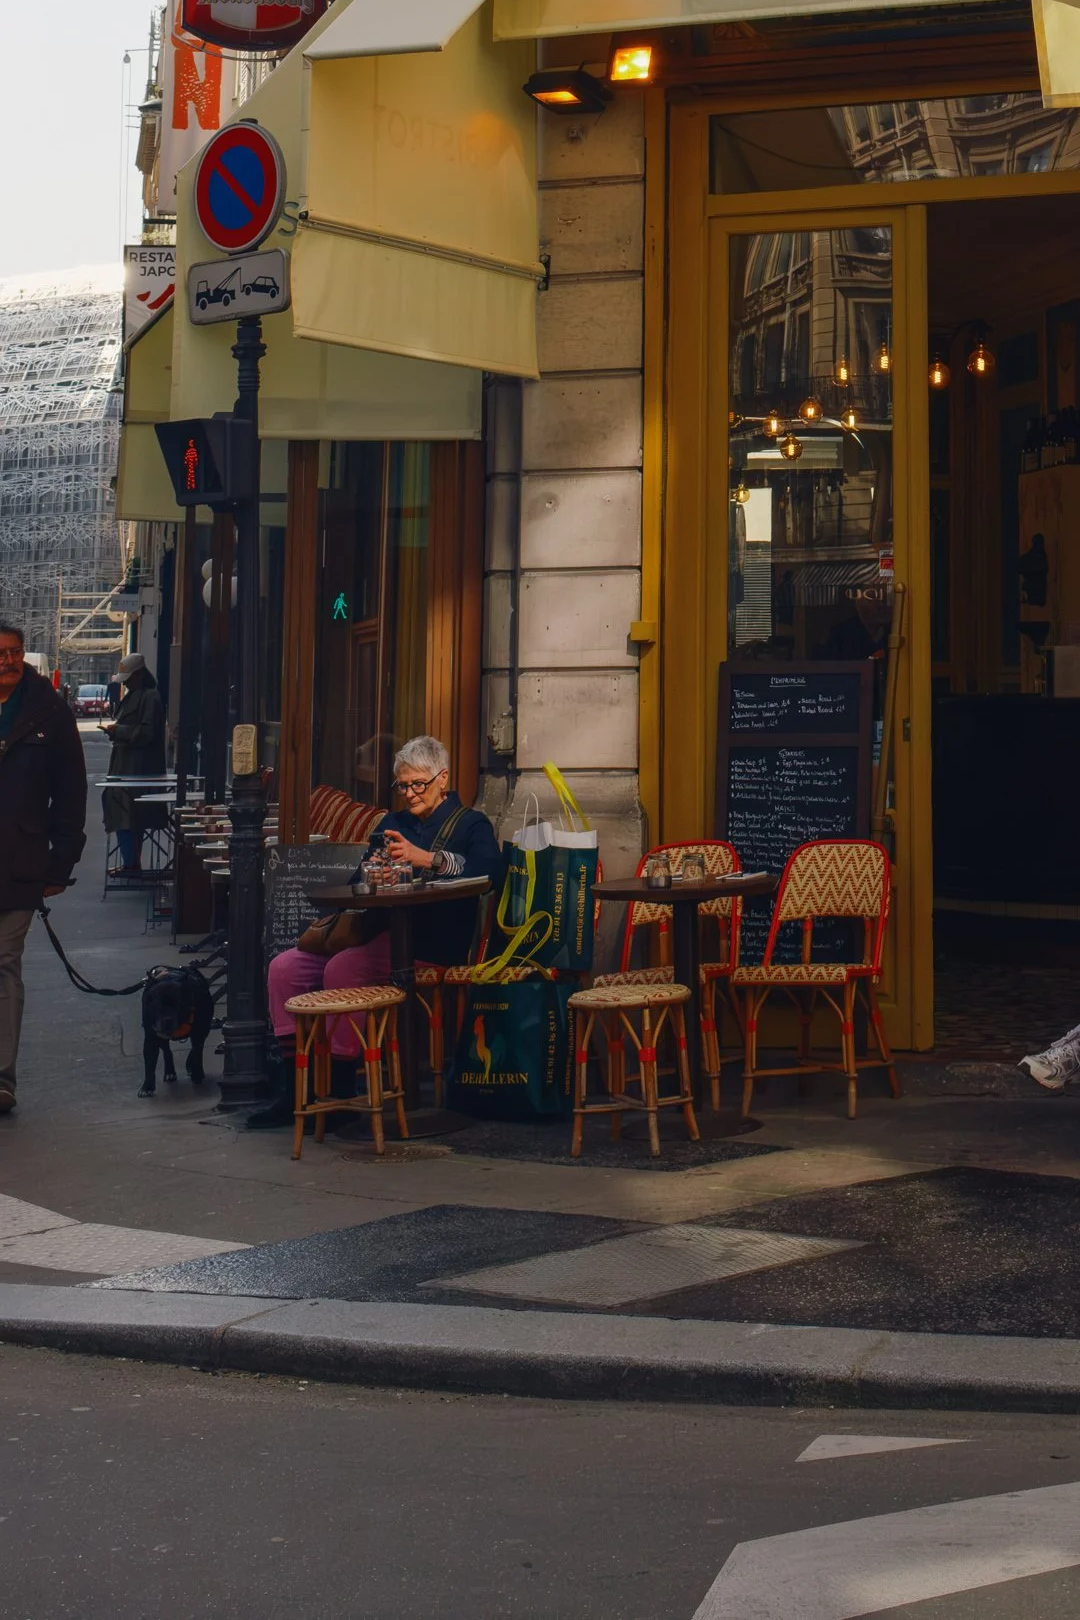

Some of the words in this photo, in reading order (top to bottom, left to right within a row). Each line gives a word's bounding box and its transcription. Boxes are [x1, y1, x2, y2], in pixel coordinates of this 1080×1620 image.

[556, 871, 565, 881] 13
[555, 883, 563, 893] 53
[554, 894, 563, 904] 36
[553, 905, 562, 915] 42
